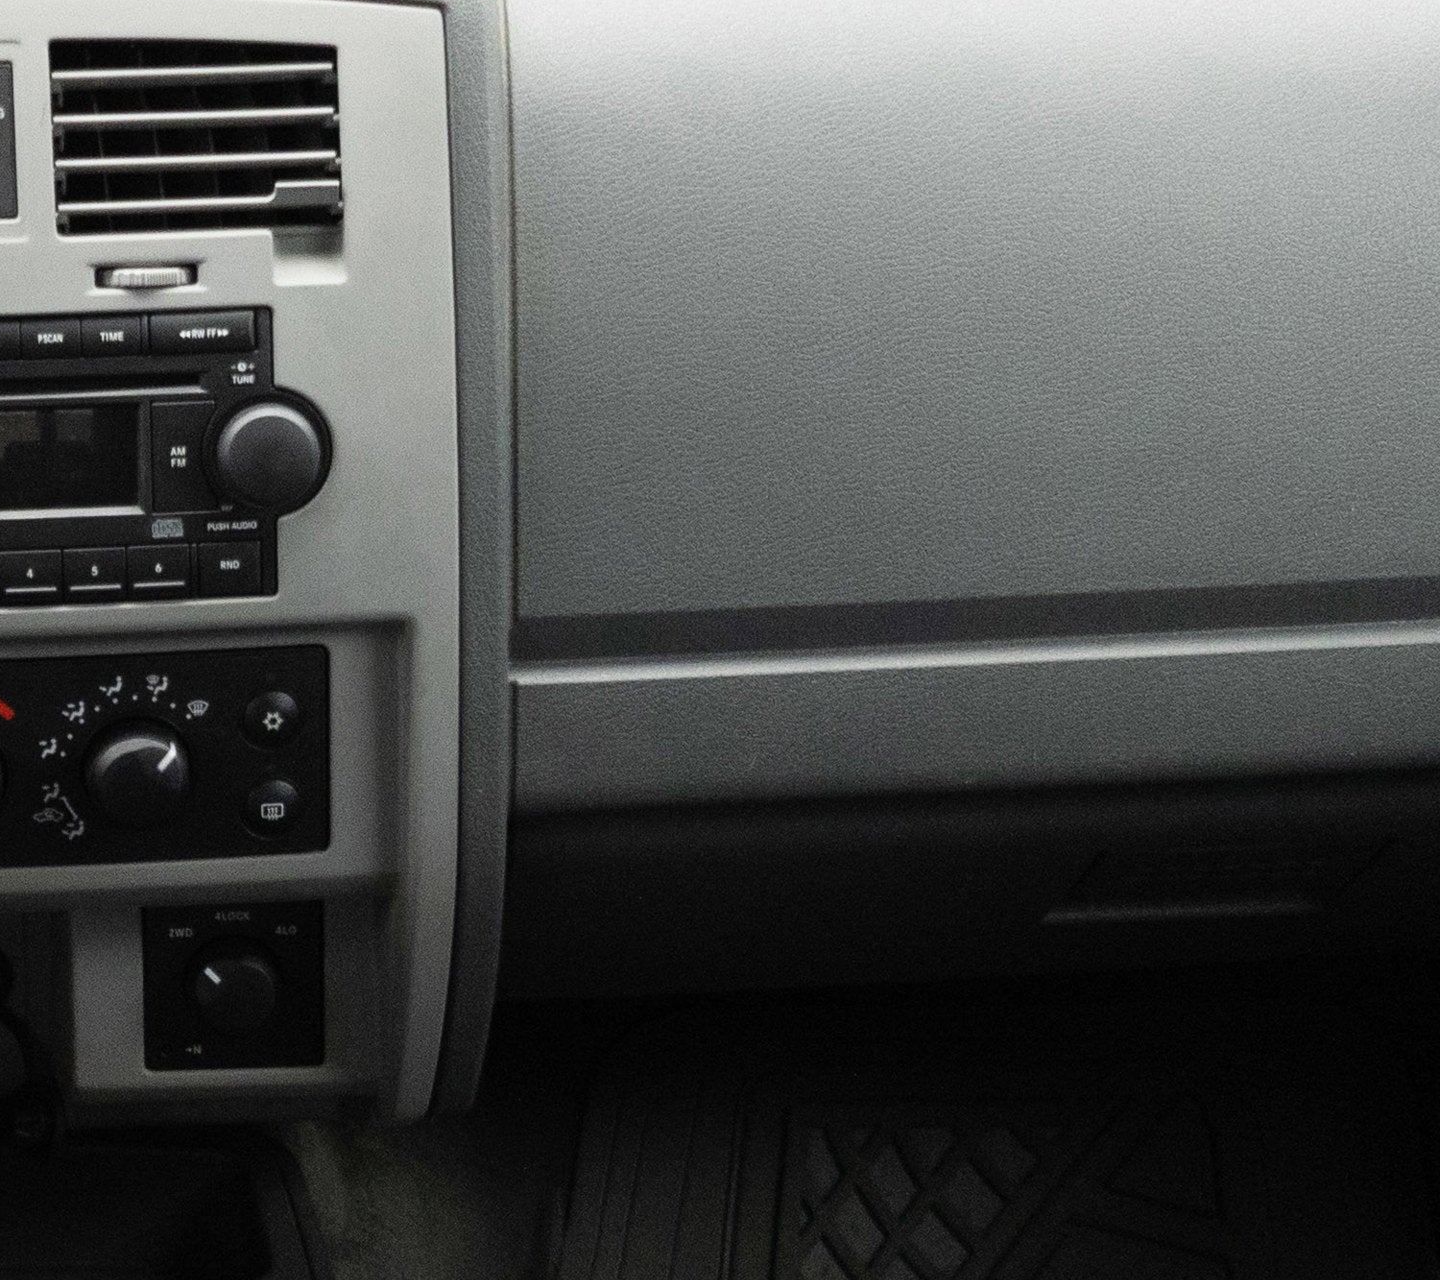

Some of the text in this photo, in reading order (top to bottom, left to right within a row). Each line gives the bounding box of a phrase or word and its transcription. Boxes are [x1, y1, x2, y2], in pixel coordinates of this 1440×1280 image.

[99, 330, 125, 343] TIME
[192, 327, 218, 339] RW FF
[37, 334, 64, 345] PSCAN
[231, 374, 255, 385] TUNE
[170, 446, 186, 457] AM
[170, 457, 186, 468] FM
[207, 520, 258, 532] PUSH AUDIO
[91, 565, 99, 577] 5
[155, 563, 163, 574] 6
[220, 560, 240, 571] RND
[26, 568, 34, 580] 4
[169, 928, 193, 938] 2WD
[274, 925, 297, 936] 4LO
